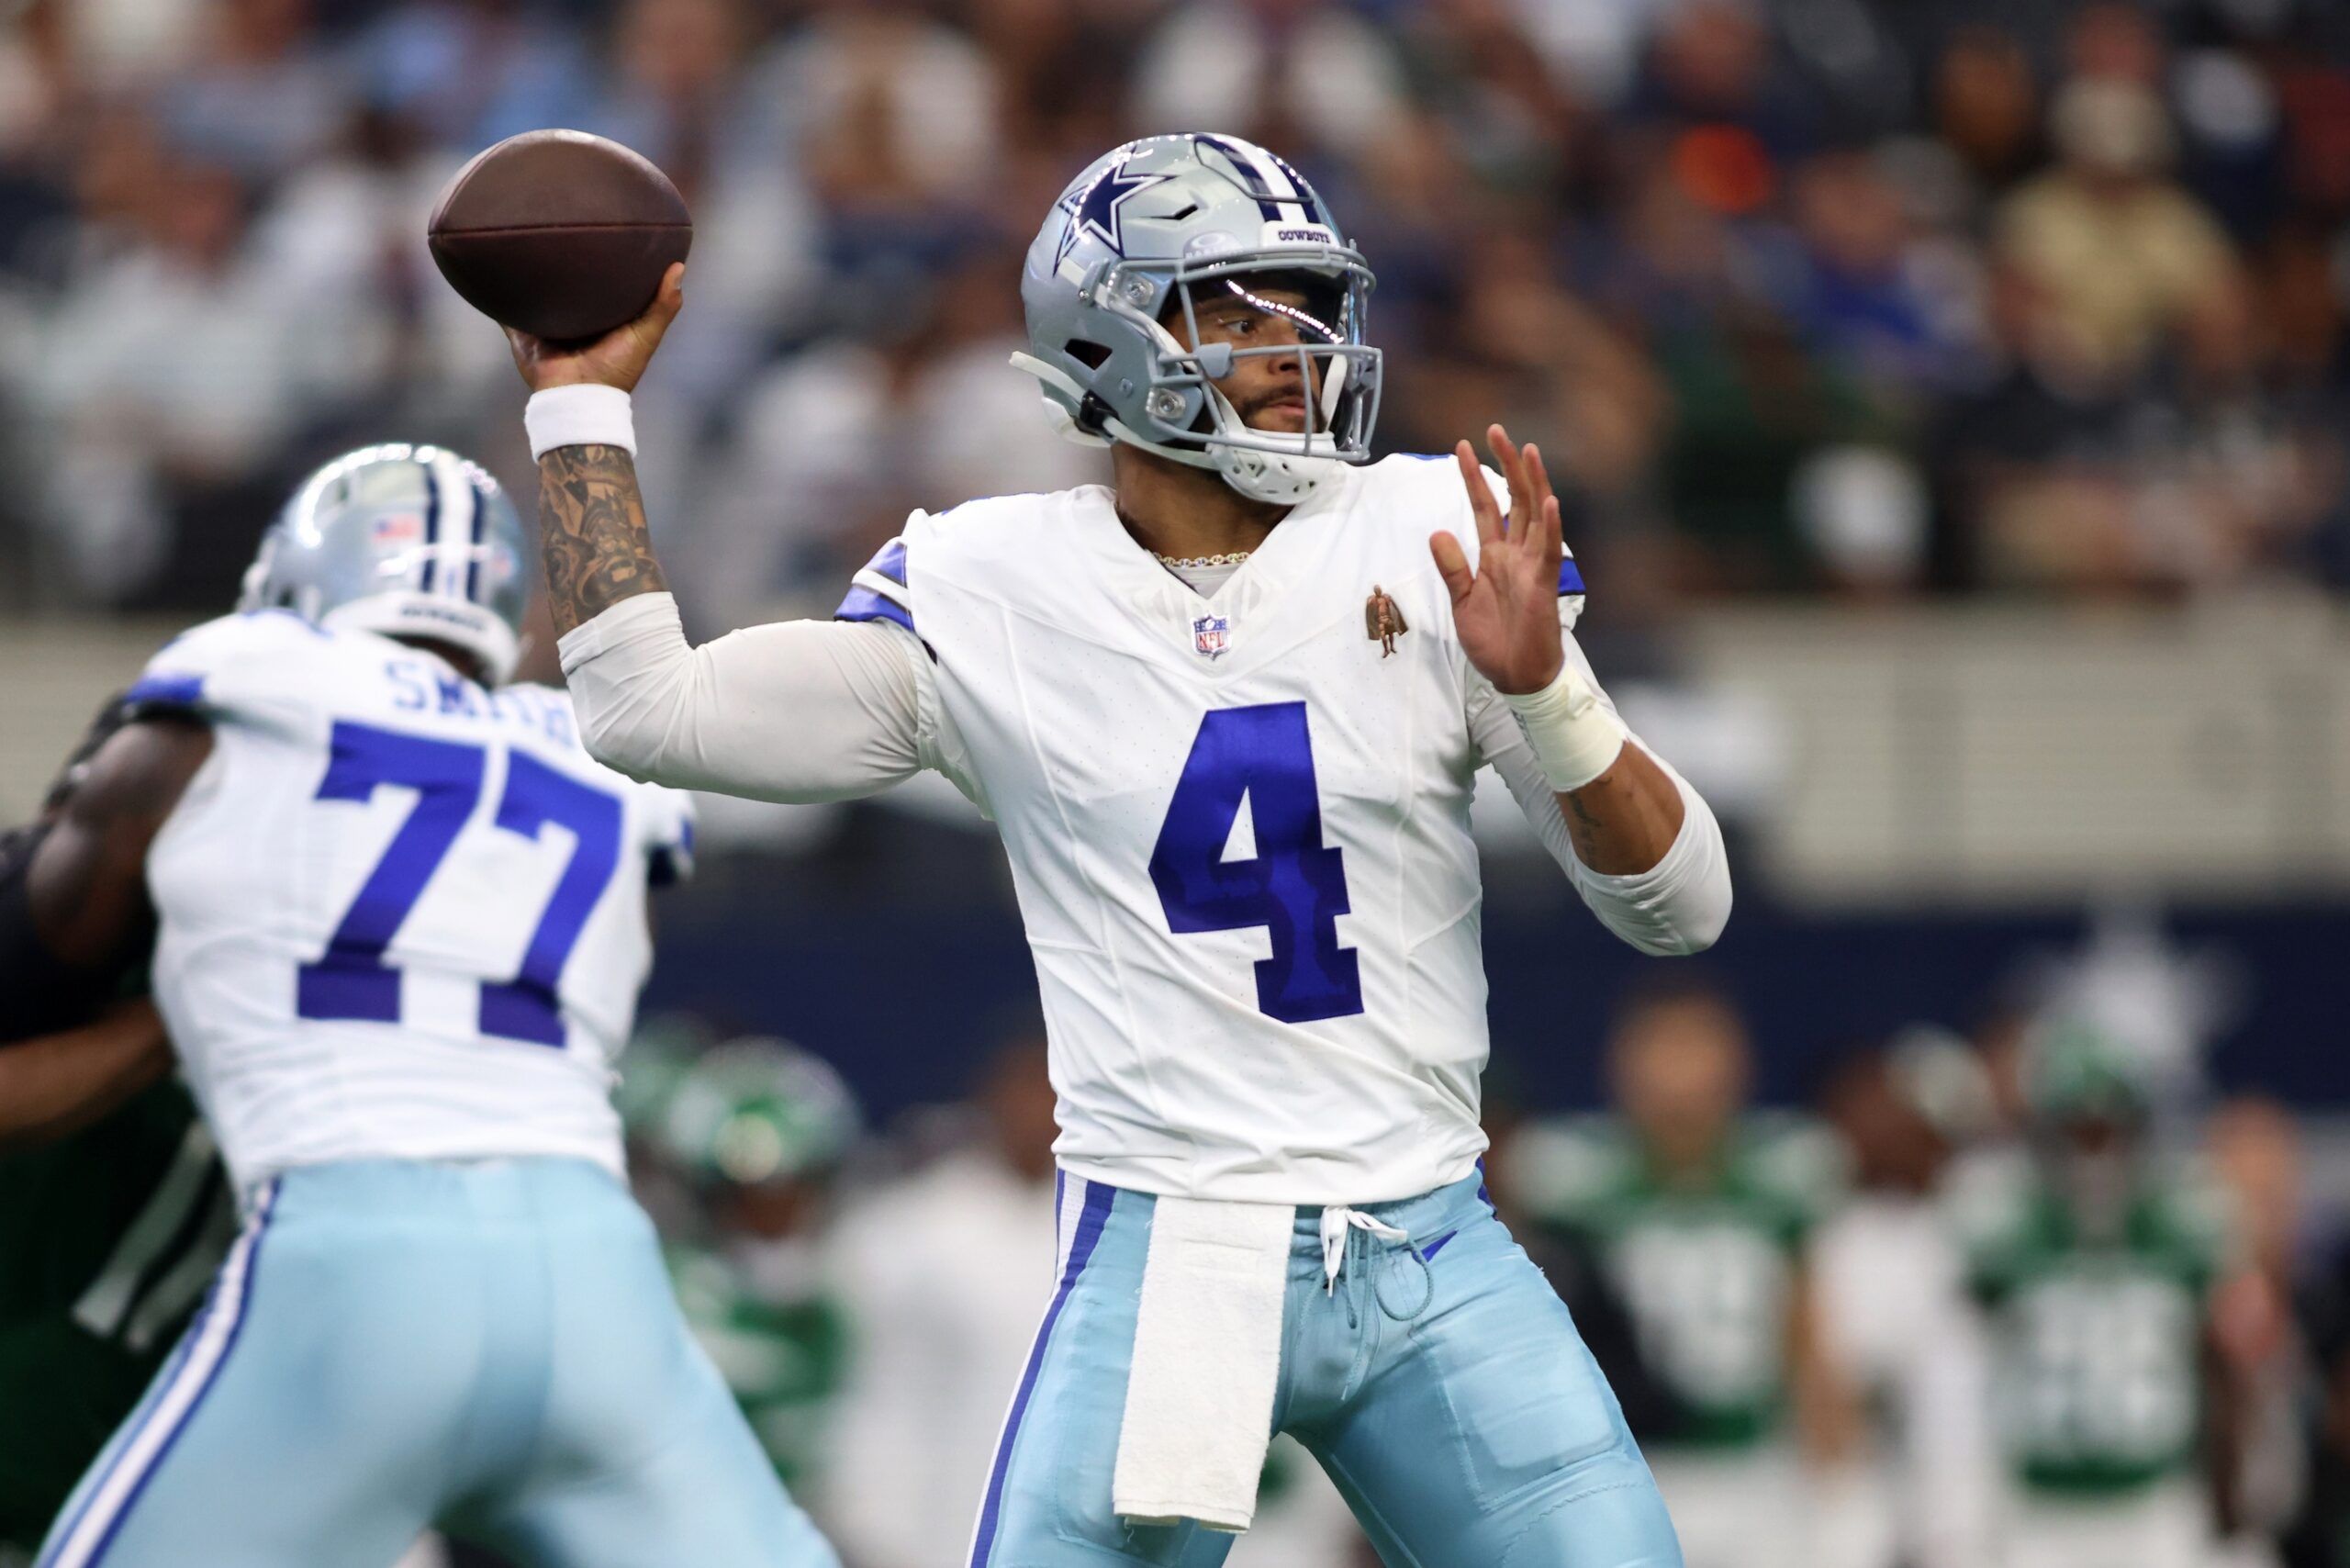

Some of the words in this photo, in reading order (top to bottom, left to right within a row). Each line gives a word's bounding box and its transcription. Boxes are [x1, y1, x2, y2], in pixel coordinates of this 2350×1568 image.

[1198, 631, 1225, 650] NFL
[297, 719, 625, 1049] 77
[1147, 700, 1365, 1024] 4
